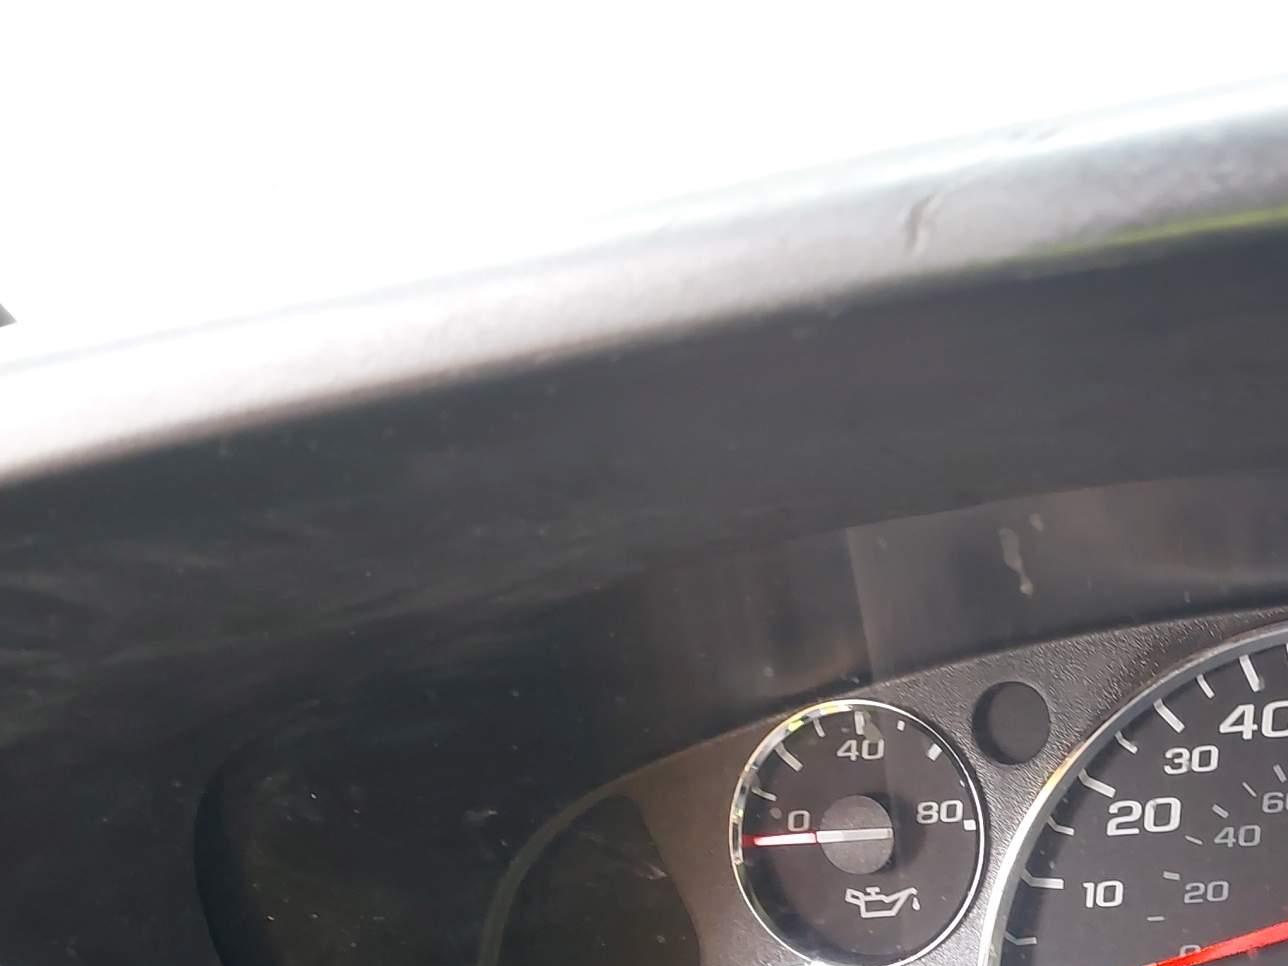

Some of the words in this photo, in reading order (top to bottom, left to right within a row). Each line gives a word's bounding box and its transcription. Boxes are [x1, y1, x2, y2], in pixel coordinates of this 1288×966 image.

[837, 739, 884, 760] 40
[1164, 746, 1218, 774] 30
[787, 810, 811, 833] 0
[916, 800, 962, 825] 80
[1105, 796, 1181, 836] 20
[1214, 825, 1261, 847] 40
[1083, 881, 1123, 907] 10
[1184, 881, 1228, 903] 20
